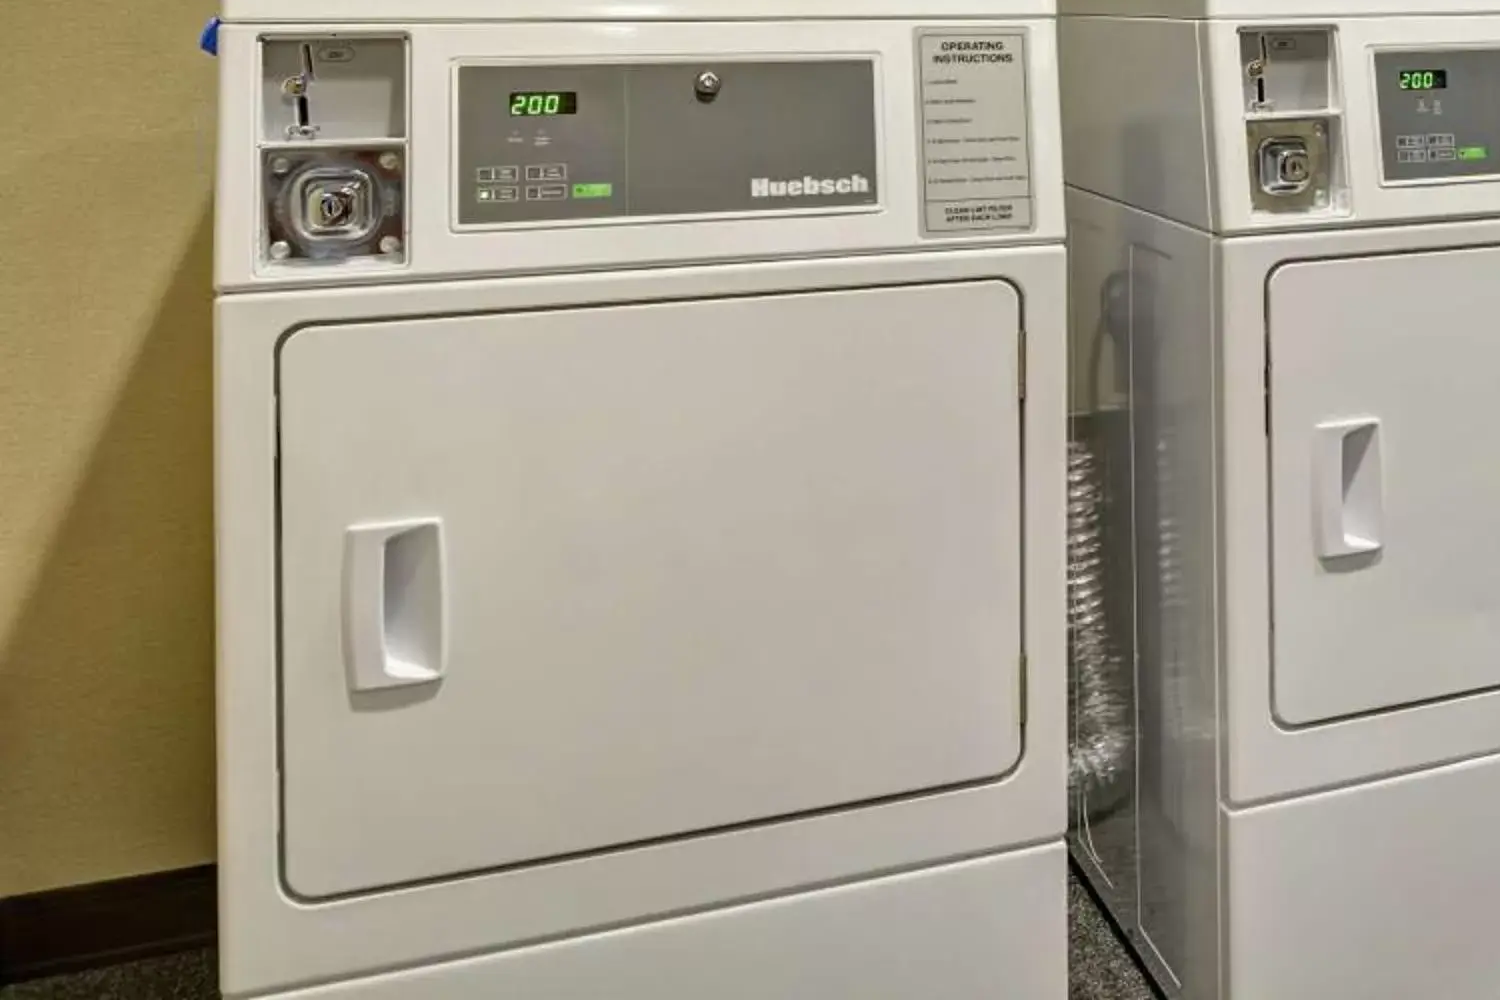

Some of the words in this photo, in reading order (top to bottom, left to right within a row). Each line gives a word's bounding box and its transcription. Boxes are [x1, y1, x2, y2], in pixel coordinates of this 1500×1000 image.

[941, 41, 1004, 51] OPERATING
[932, 53, 1014, 64] INSTRUCTIONS
[1400, 72, 1433, 89] 200
[511, 95, 560, 115] 200
[751, 174, 869, 198] Huebsch
